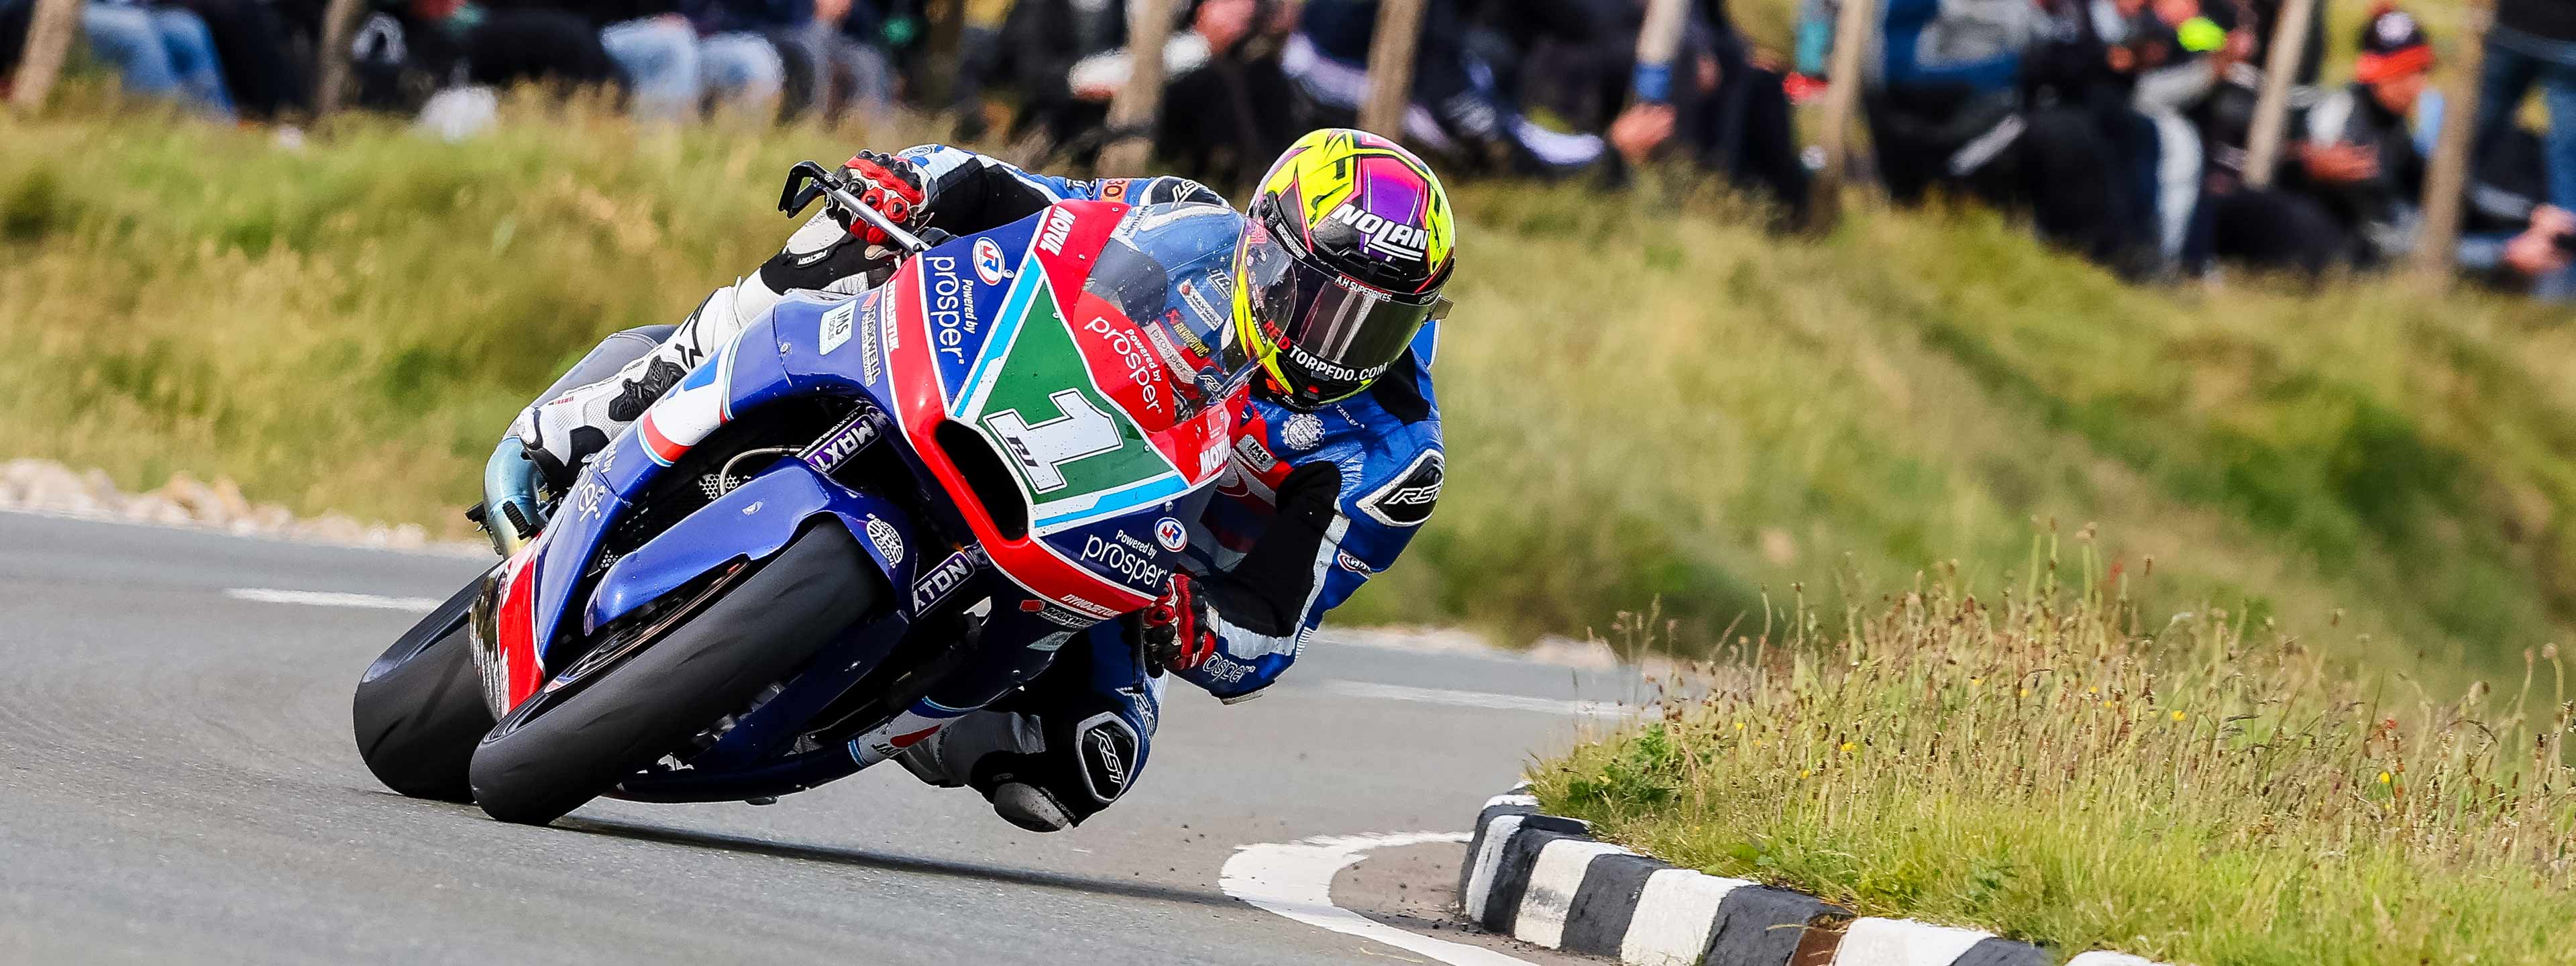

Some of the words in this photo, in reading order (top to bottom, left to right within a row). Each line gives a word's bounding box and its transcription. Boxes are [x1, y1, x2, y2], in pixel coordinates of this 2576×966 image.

[1039, 206, 1077, 256] MOTUL
[1330, 203, 1430, 258] NOLAN
[962, 279, 977, 320] Powered
[1348, 281, 1393, 302] SUPERBIKES
[828, 315, 836, 341] TOOLS
[836, 308, 852, 335] IMS
[963, 321, 979, 334] by
[867, 307, 879, 383] MAXWELL
[1124, 328, 1159, 369] Powered
[1152, 368, 1162, 382] by
[1150, 329, 1187, 373] prosper
[1263, 320, 1291, 350] RED
[1289, 345, 1388, 382] TORPEDO.COM
[983, 387, 1124, 494] 1
[1248, 441, 1269, 462] IMS
[875, 538, 896, 569] Group
[1115, 529, 1148, 554] Powered
[1148, 543, 1158, 559] by
[1091, 728, 1126, 789] RST
